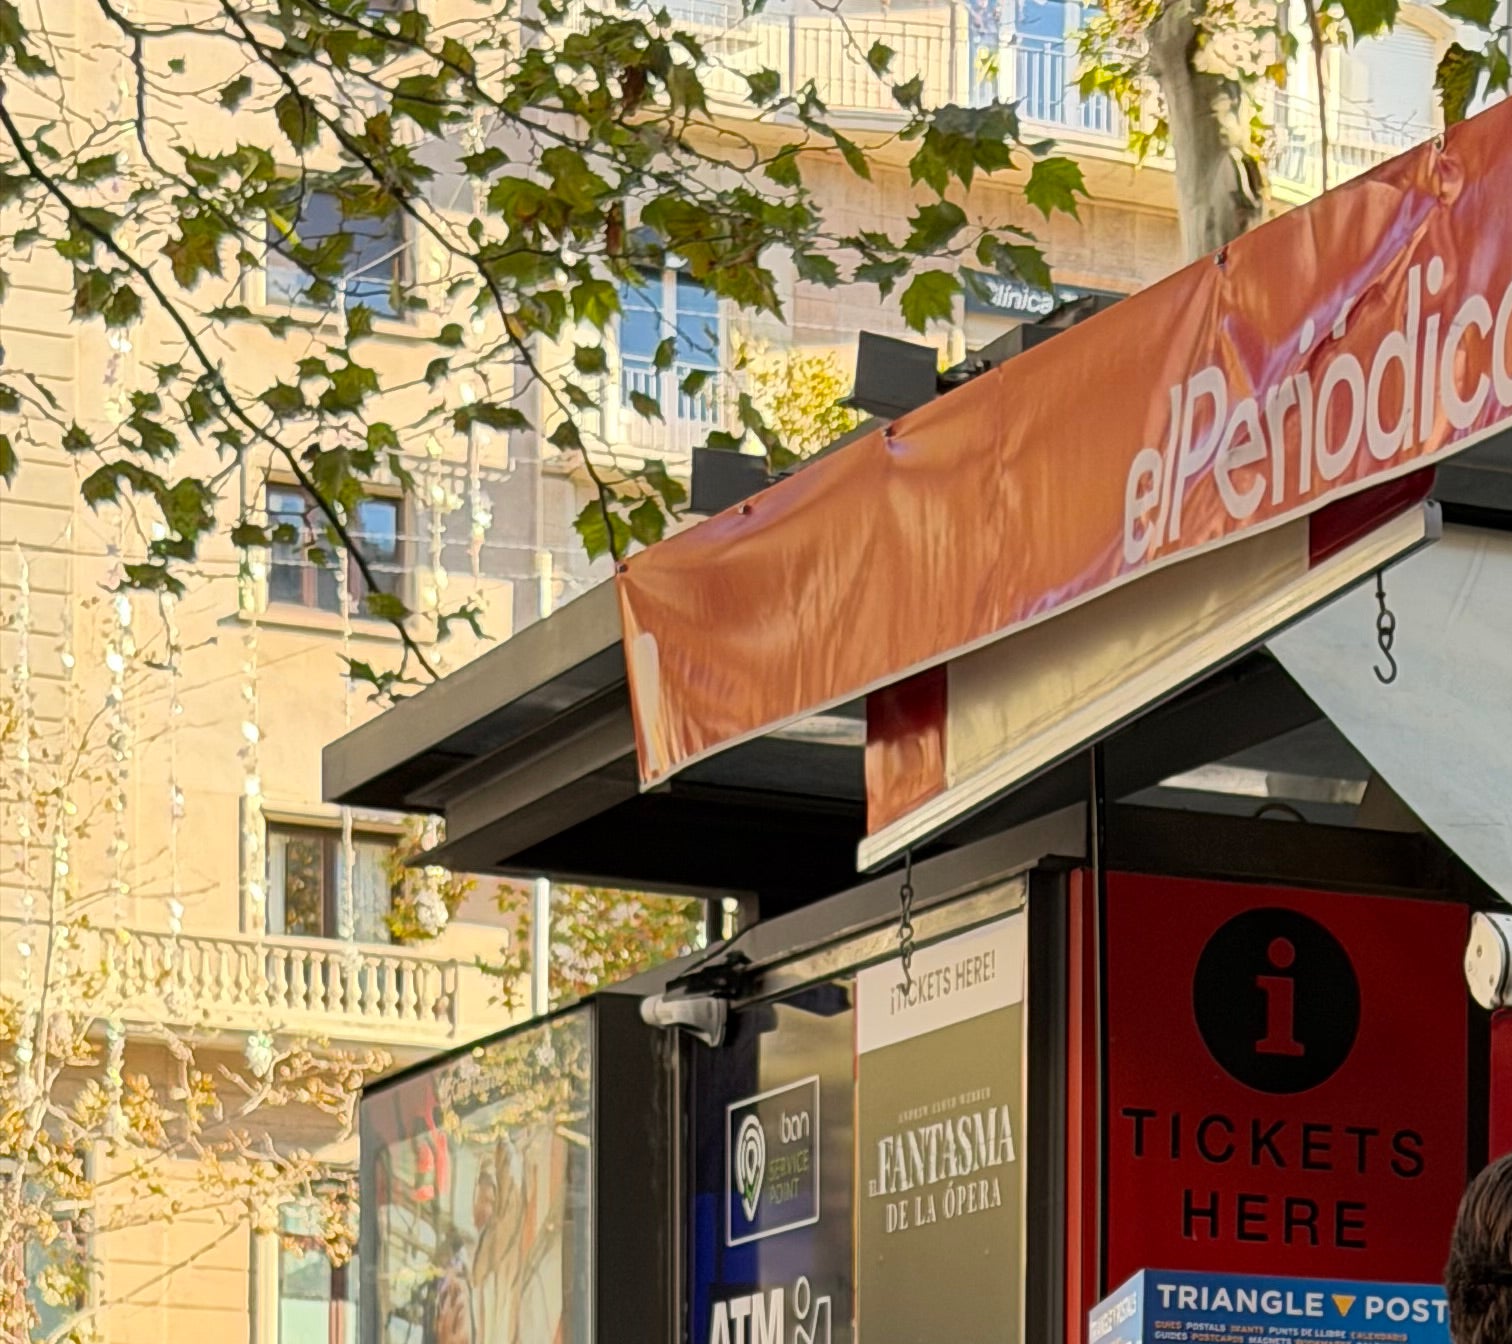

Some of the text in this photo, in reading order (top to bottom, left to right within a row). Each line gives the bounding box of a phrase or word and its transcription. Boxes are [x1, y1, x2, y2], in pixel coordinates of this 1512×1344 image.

[955, 949, 996, 991] HERE!
[878, 1104, 1016, 1196] FANTASMA
[1121, 1106, 1424, 1179] TICKETS
[886, 1177, 1002, 1233] DE LA ÓPERA
[1182, 1188, 1368, 1249] HERE
[1157, 1284, 1324, 1317] TRIANGLE
[1365, 1296, 1449, 1324] POST
[1186, 1322, 1226, 1333] POSTALS
